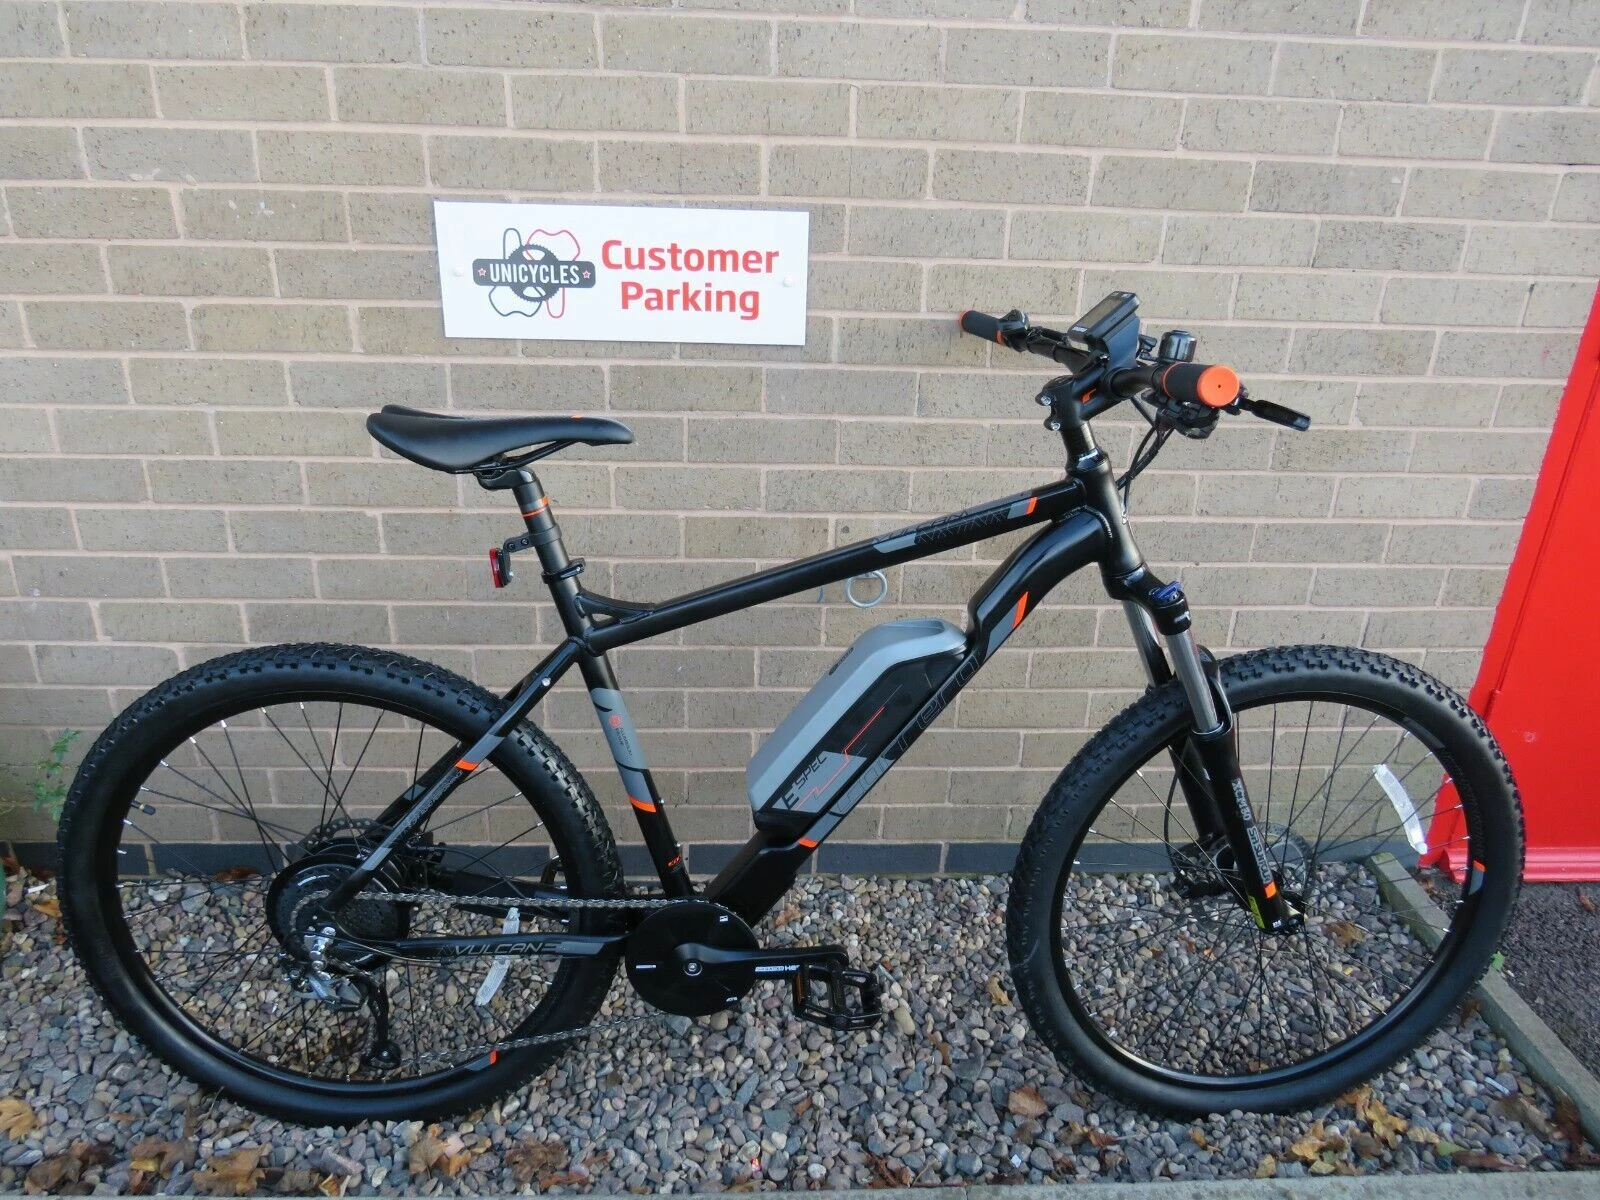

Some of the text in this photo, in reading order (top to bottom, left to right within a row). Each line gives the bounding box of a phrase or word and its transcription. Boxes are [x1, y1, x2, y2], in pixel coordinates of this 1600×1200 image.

[489, 262, 580, 285] UNICYCLES
[602, 239, 780, 274] Customer
[621, 281, 760, 321] Parking
[795, 755, 827, 790] SPEC
